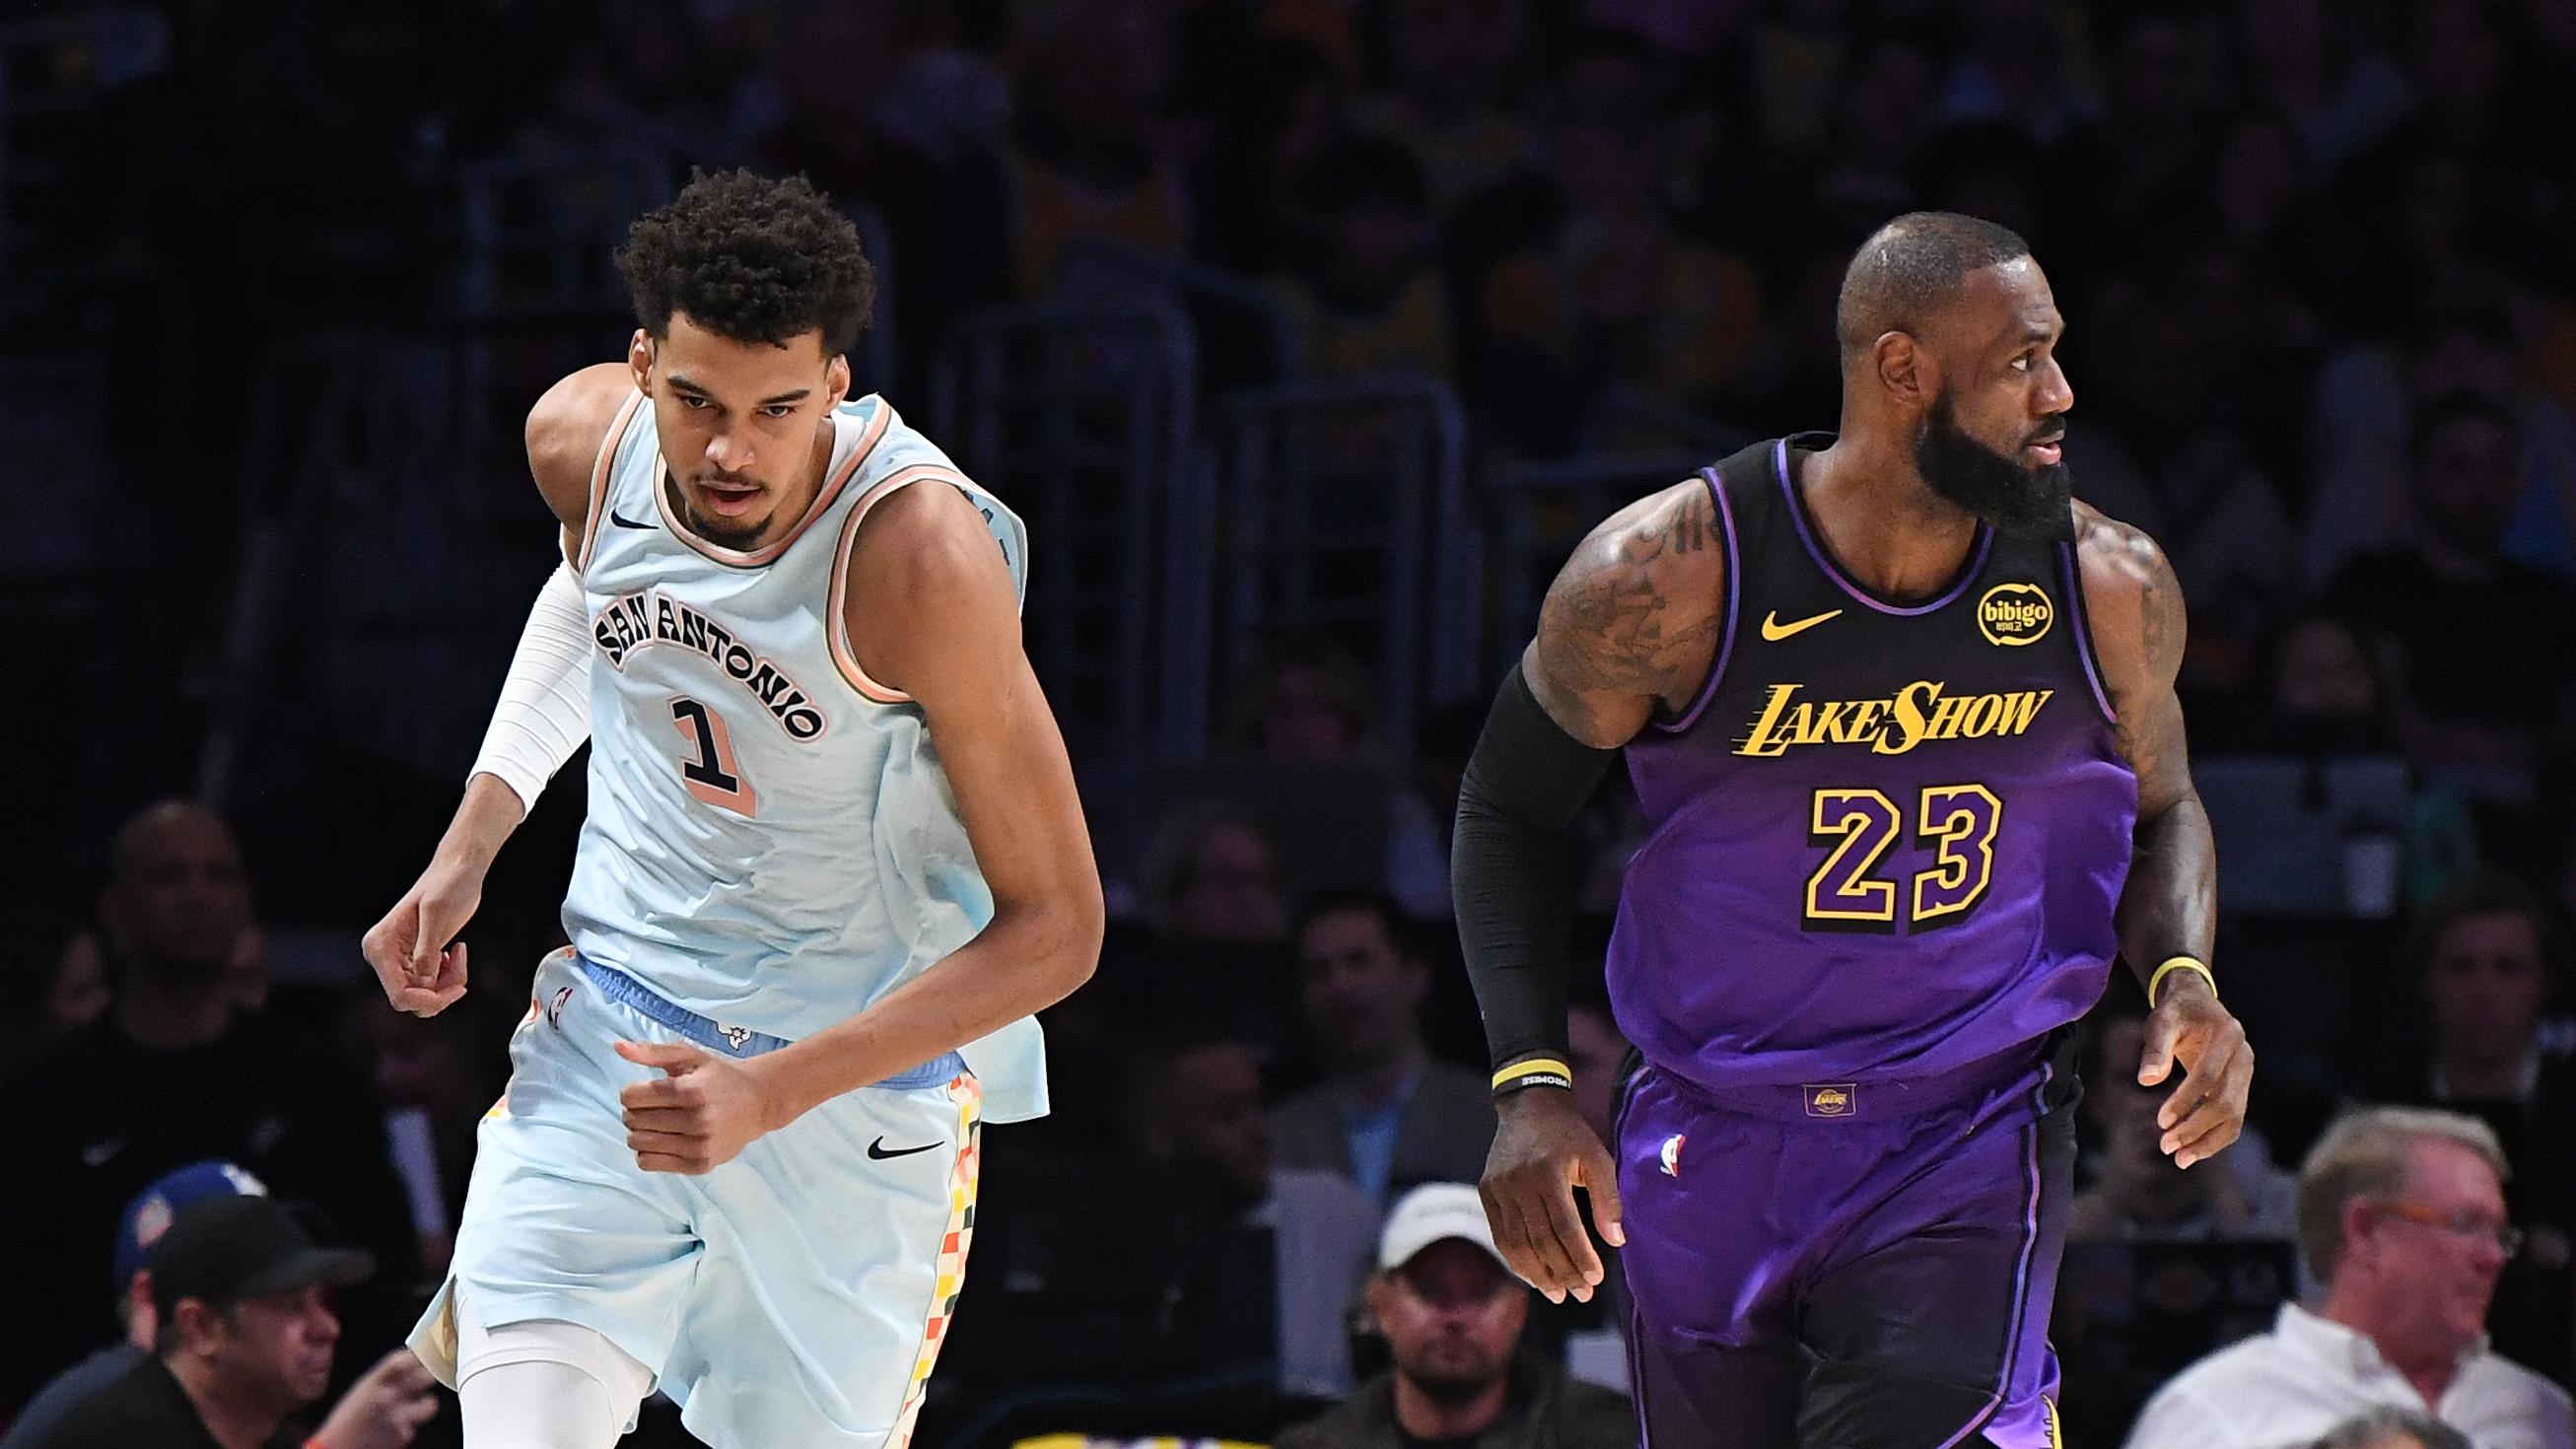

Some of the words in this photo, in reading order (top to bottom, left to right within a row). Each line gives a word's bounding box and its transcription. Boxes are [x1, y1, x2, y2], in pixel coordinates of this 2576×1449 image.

[593, 593, 653, 667] SAN
[657, 595, 826, 740] ANTONIO
[1984, 599, 2049, 628] bibigo
[669, 697, 740, 796] 1
[1805, 783, 2003, 923] 23
